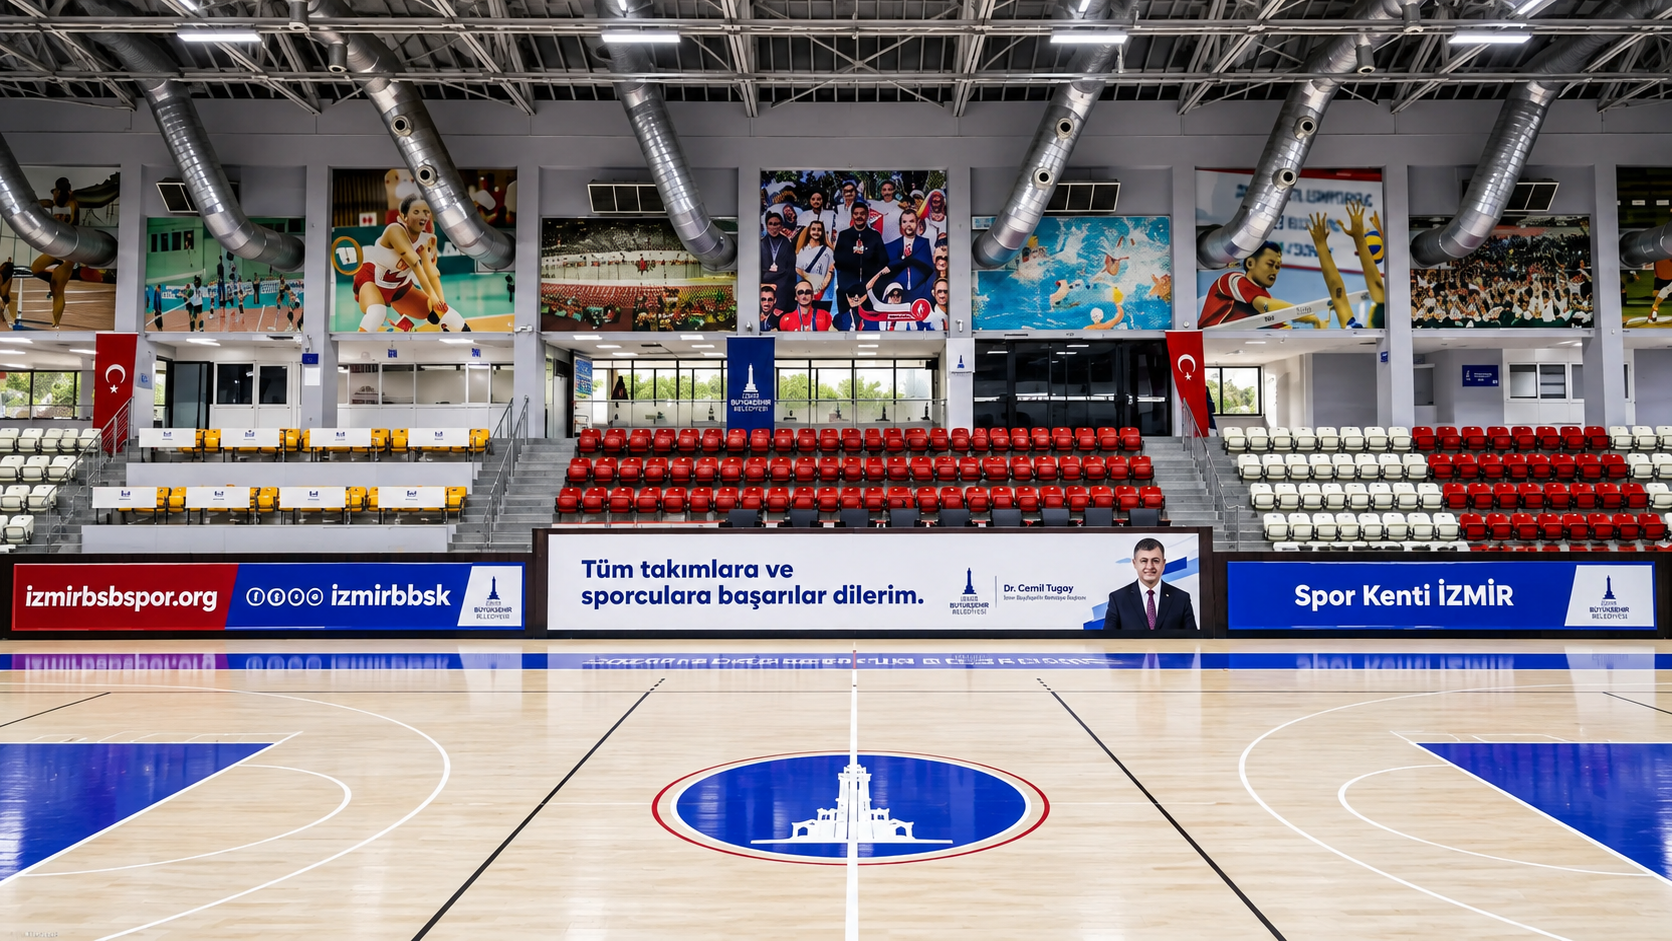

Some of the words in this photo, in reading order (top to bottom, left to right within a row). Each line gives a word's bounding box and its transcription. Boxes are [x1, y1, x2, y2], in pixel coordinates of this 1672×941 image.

[581, 559, 634, 579] Tüm
[640, 559, 759, 579] takımlara
[765, 563, 794, 579] ve
[25, 585, 218, 612] izmirbsbspor.org
[331, 583, 451, 606] izmirbbsk
[581, 585, 712, 610] sporculara
[718, 585, 827, 611] başarılar
[832, 584, 925, 605] dilerim.
[1003, 584, 1016, 593] Dr.
[1018, 583, 1045, 593] Cemil
[1046, 584, 1074, 595] Tugay
[1294, 584, 1356, 612] Spor
[1363, 583, 1431, 606] Kenti
[1438, 578, 1514, 606] İZMİR
